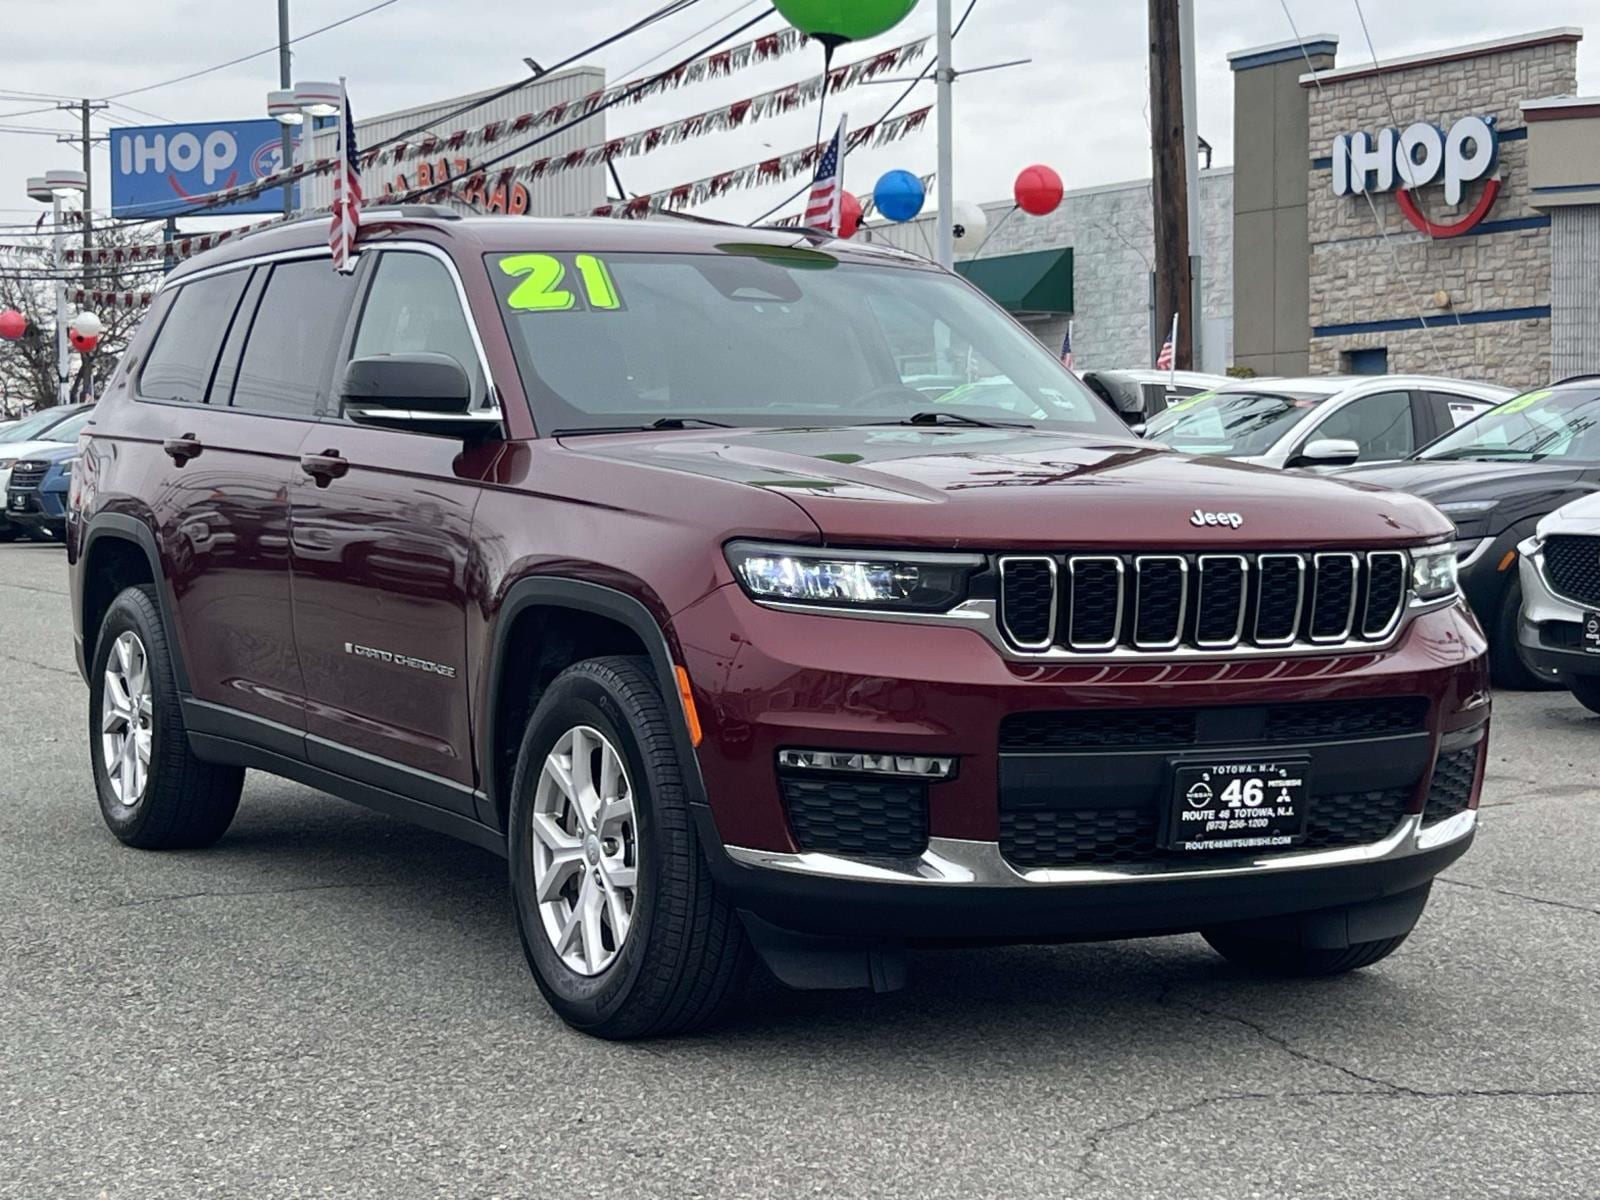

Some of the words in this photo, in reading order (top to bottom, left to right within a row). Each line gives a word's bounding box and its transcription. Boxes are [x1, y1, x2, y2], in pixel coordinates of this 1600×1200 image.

[499, 254, 620, 311] 21
[1189, 509, 1243, 529] Jeep
[354, 644, 393, 662] GRAND
[394, 654, 456, 678] CHEROKEE
[1220, 778, 1264, 808] 46
[1182, 810, 1215, 821] ROUTE
